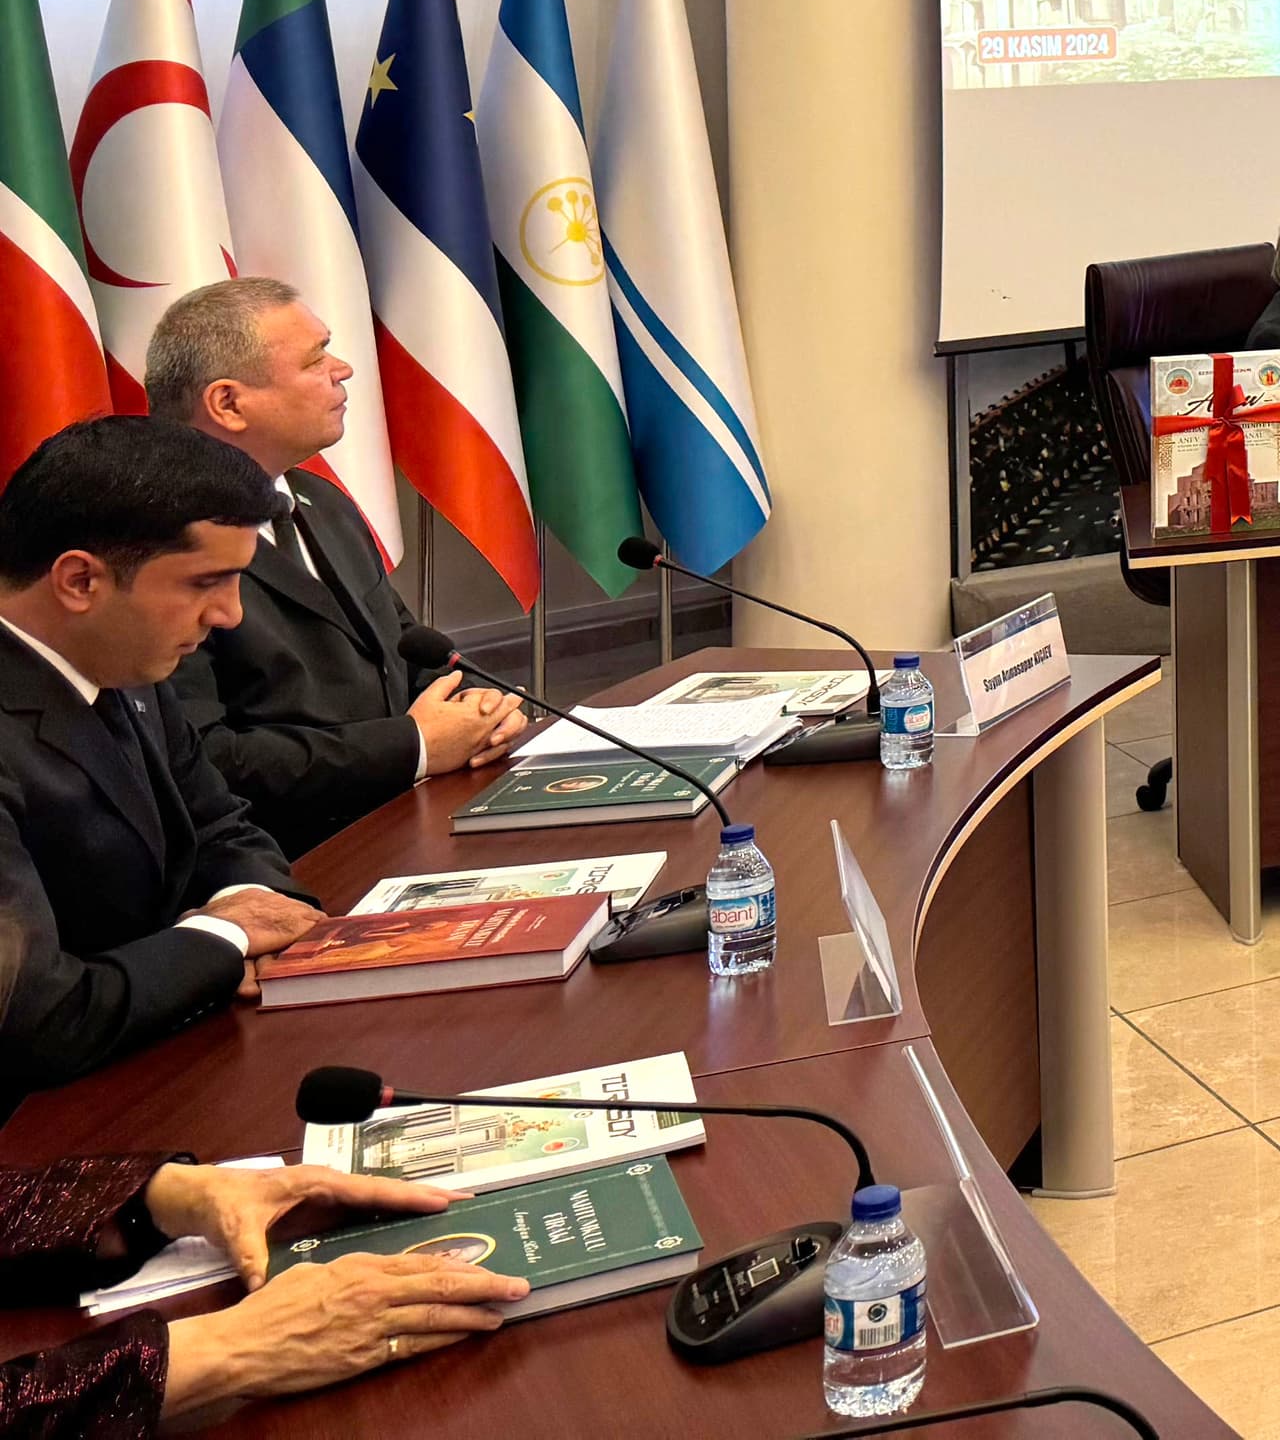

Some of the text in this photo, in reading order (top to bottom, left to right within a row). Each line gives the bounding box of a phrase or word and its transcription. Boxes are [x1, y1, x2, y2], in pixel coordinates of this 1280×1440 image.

[981, 32, 1110, 59] 29 KASIM 2024
[711, 906, 753, 924] abant
[600, 1072, 637, 1139] TÜRSOY
[569, 1188, 608, 1252] MAHTUMKULU
